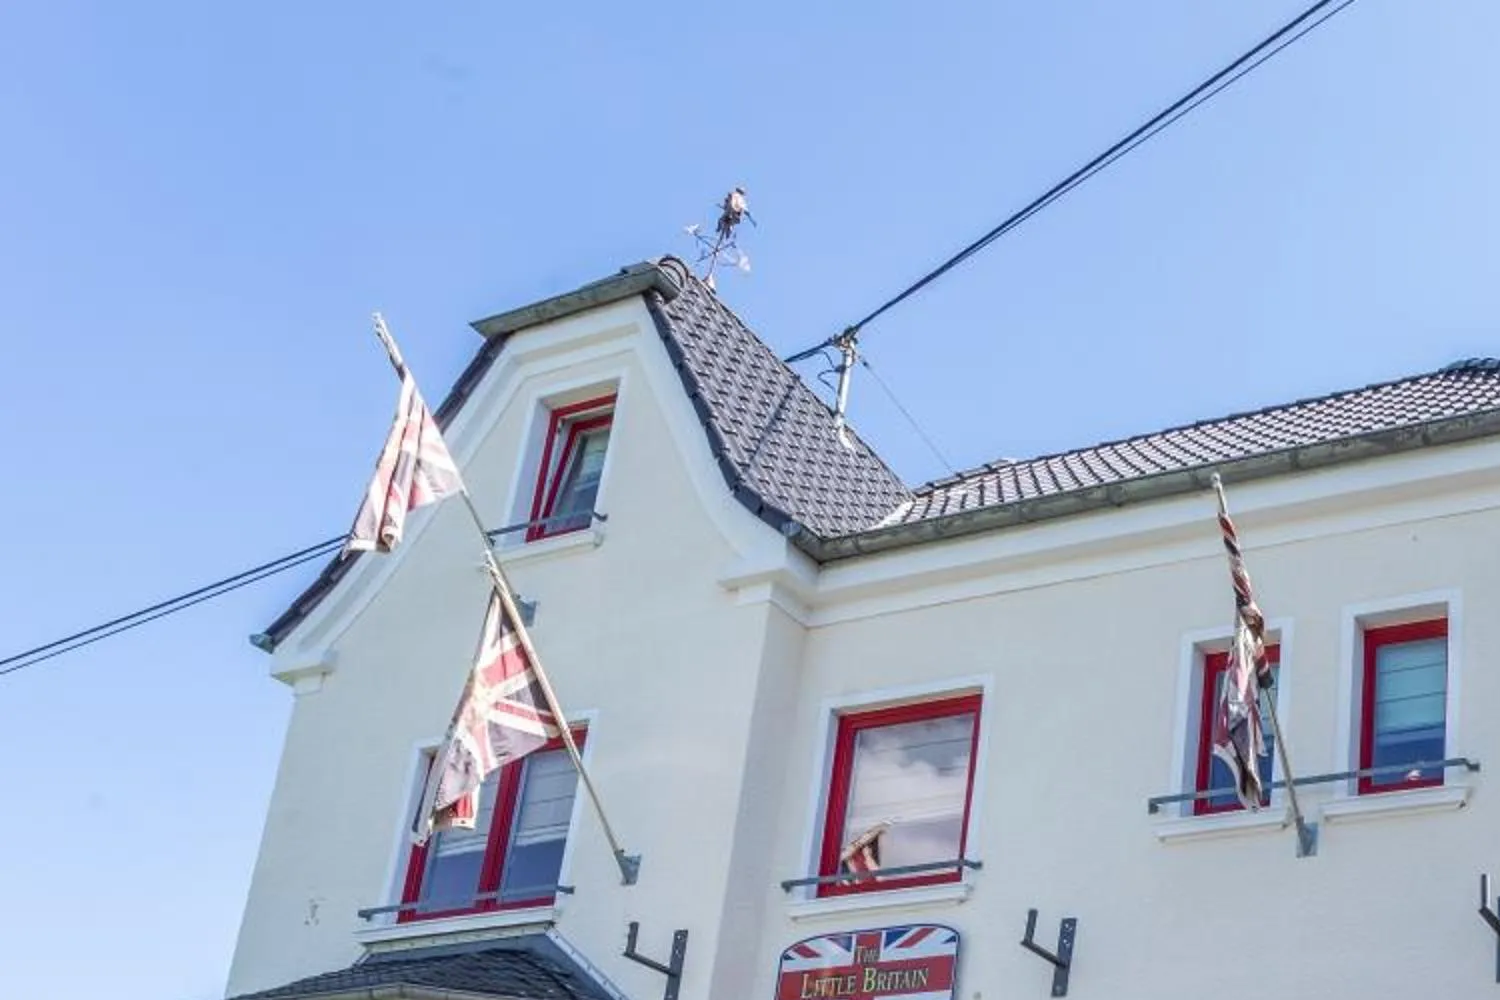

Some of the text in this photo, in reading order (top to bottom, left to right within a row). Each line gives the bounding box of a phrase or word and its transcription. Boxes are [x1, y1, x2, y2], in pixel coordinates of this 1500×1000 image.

[856, 945, 880, 963] THE
[800, 967, 929, 999] LITTLE BRITAIN
